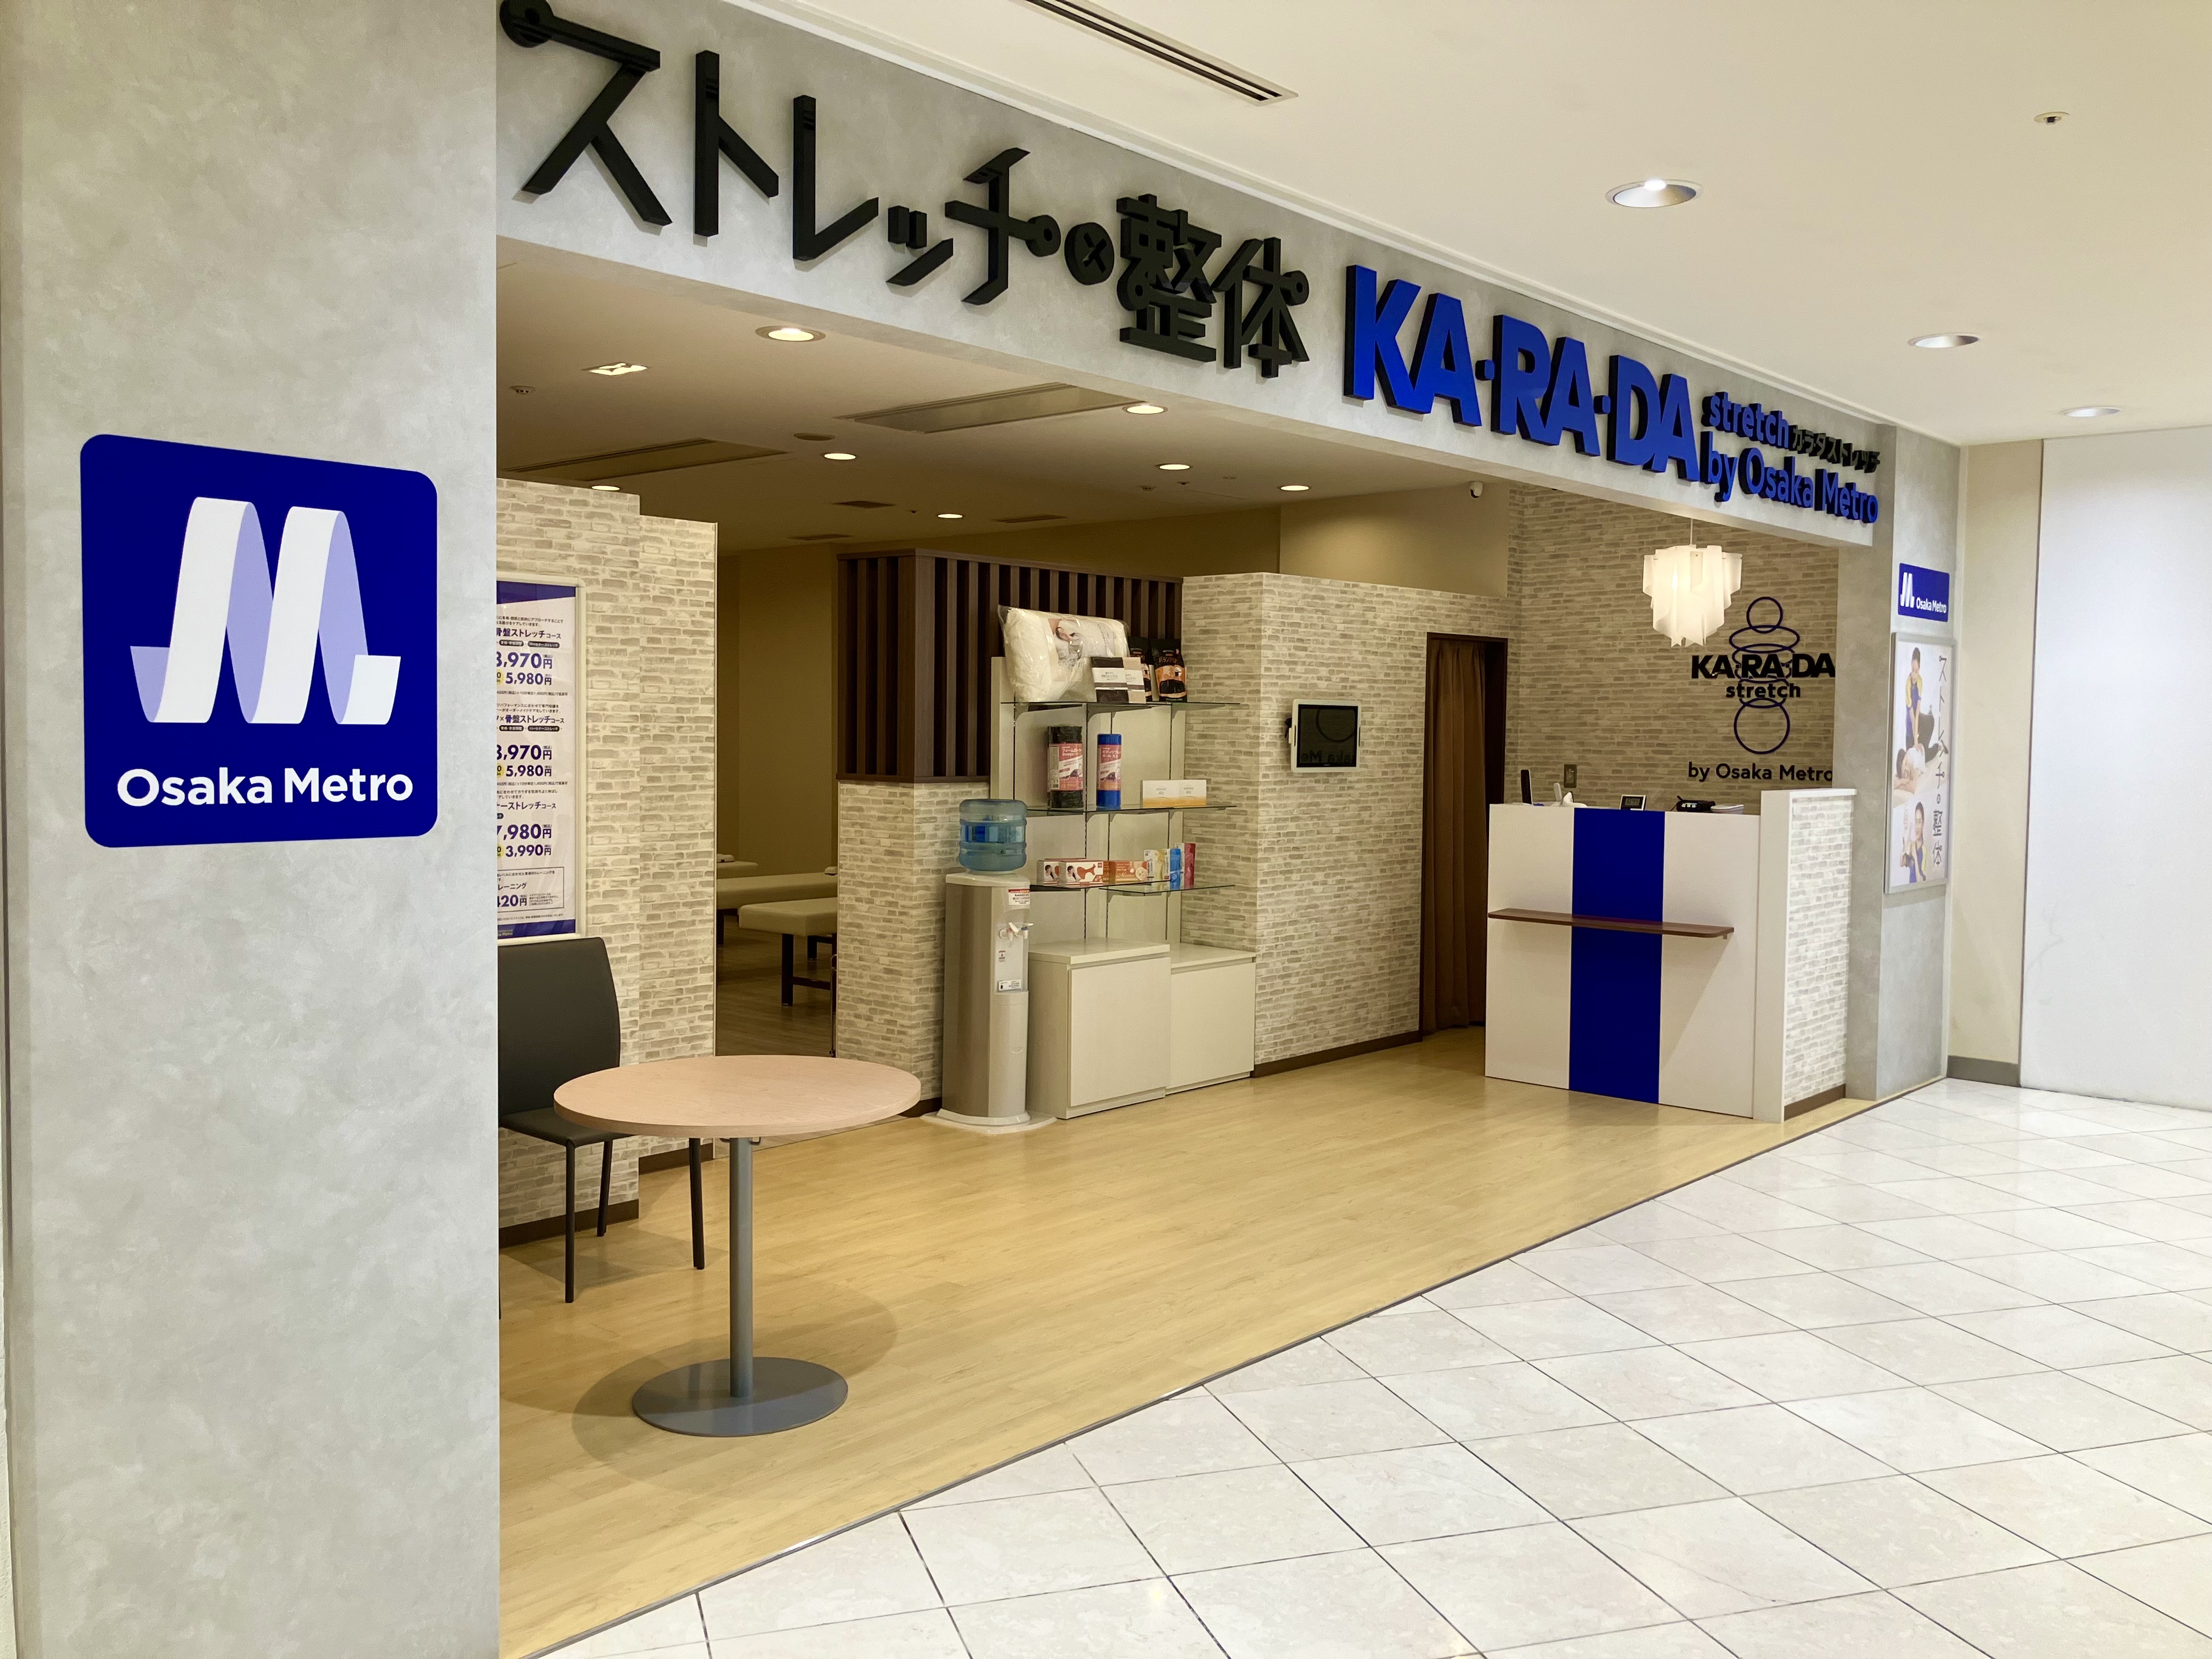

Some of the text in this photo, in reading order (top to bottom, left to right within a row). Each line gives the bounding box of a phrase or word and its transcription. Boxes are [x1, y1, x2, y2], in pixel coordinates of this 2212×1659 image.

[1701, 391, 1789, 449] stretch
[1701, 431, 1878, 523] by Osaka Metro
[1916, 597, 1947, 613] Osaka Metro
[505, 672, 552, 685] 5,980円
[1725, 683, 1801, 698] stretch
[506, 765, 552, 777] 5,980円
[1688, 761, 1833, 782] by Osaka Metro
[117, 766, 413, 807] Osaka Metro
[505, 844, 551, 857] 3,990円
